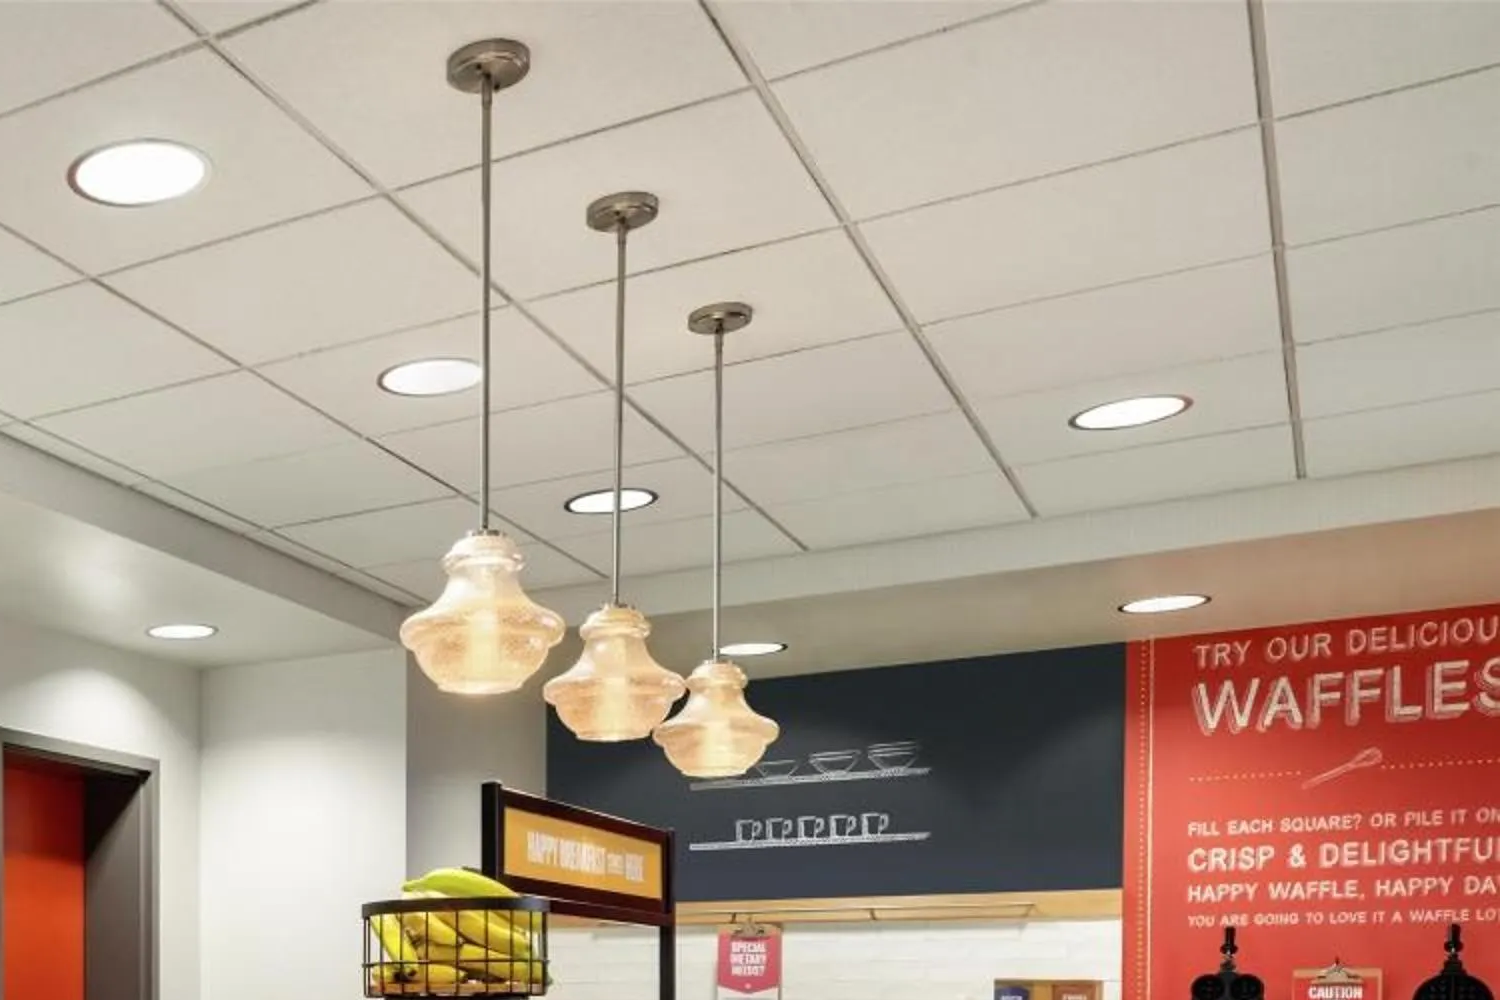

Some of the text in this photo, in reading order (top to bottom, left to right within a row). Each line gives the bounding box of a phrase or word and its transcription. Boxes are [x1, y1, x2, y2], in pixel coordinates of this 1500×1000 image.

[1193, 640, 1251, 669] TRY
[1265, 633, 1332, 663] OUR
[1191, 656, 1500, 736] WAFFLES
[1187, 821, 1221, 837] FILL
[1227, 818, 1273, 835] EACH
[1280, 813, 1362, 833] SQUARE?
[1370, 812, 1397, 828] OR
[1403, 809, 1444, 827] PILE
[1450, 808, 1467, 825] IT
[1187, 845, 1275, 873] CRISP
[1288, 843, 1307, 868] &
[1187, 882, 1258, 903] HAPPY
[1375, 875, 1454, 897] HAPPY
[1187, 915, 1216, 928] YOU
[1220, 913, 1249, 927] ARE
[1253, 912, 1299, 926] GOING
[1305, 911, 1324, 925] TO
[1329, 911, 1367, 925] LOVE
[1372, 910, 1386, 924] IT
[1391, 910, 1404, 924] A
[1409, 907, 1470, 923] WAFFLE
[731, 941, 767, 953] SPECIAL
[1308, 986, 1363, 1000] CAUTION
